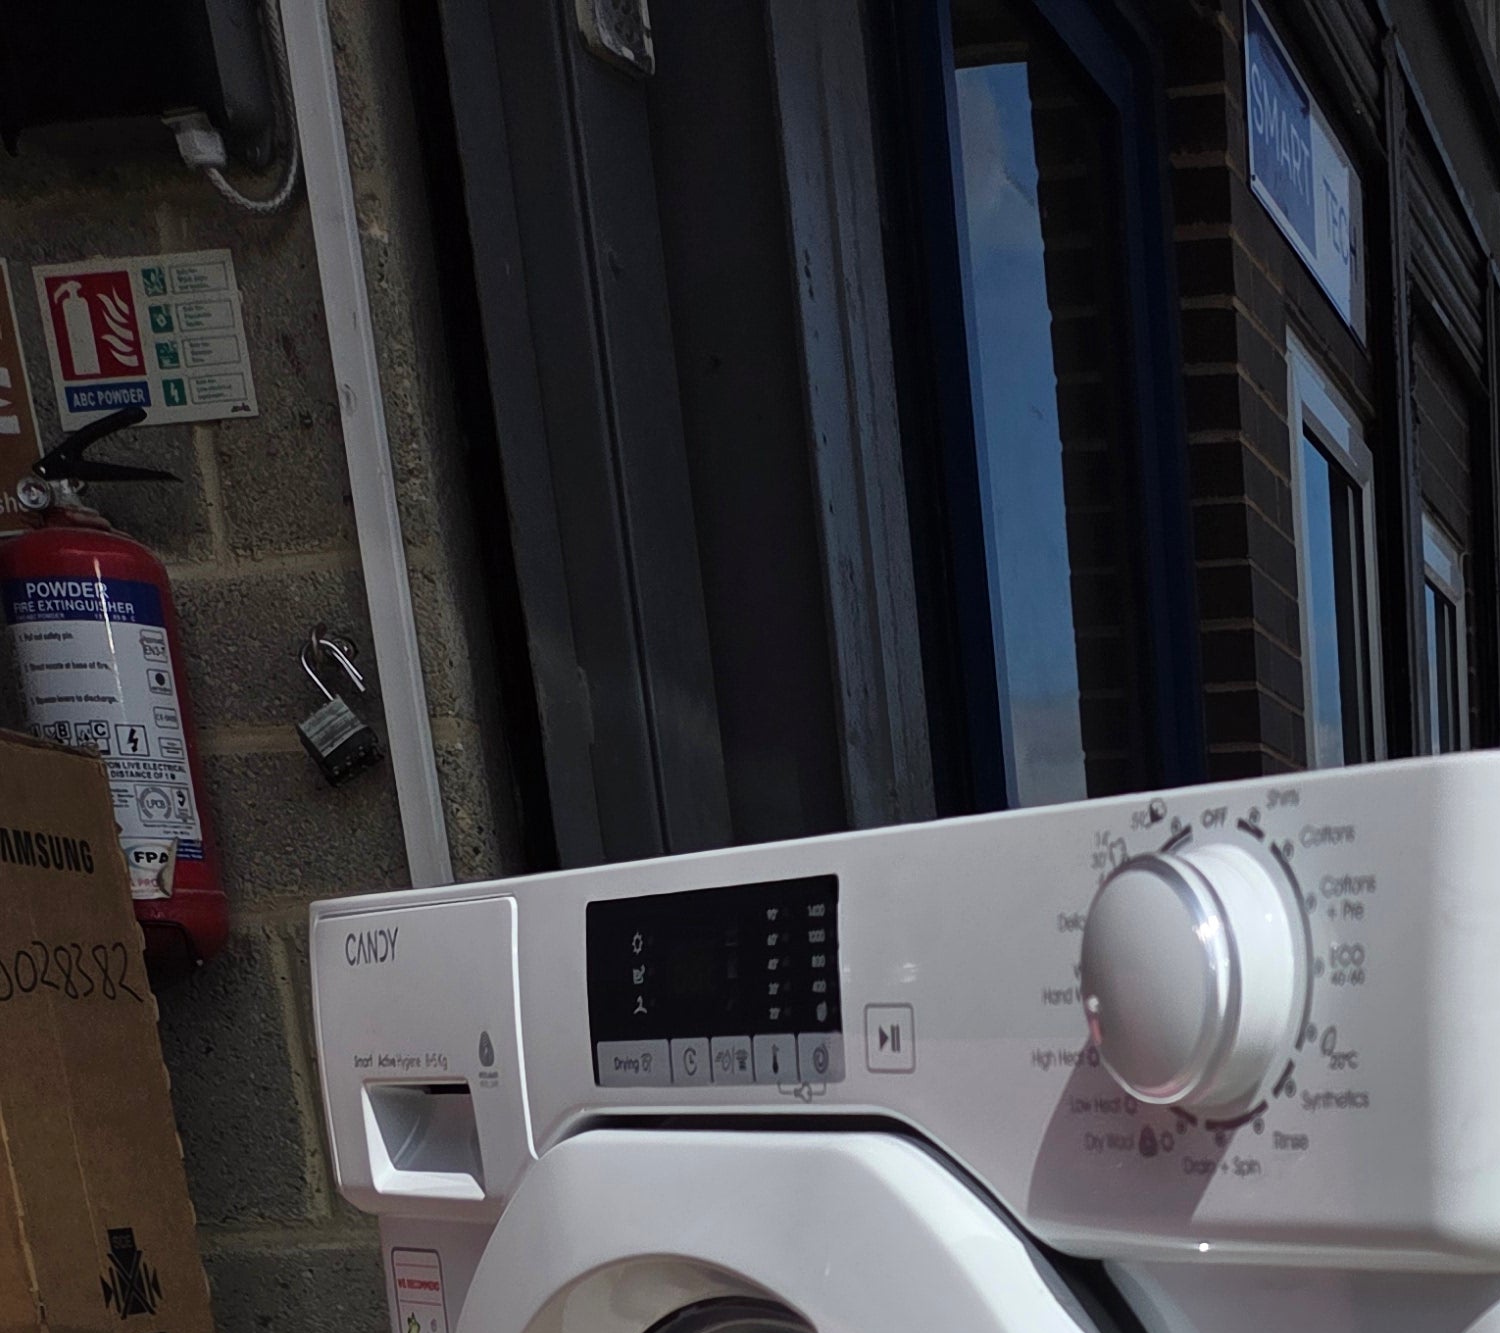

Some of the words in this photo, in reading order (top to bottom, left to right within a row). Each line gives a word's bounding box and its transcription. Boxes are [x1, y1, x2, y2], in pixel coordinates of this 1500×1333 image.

[1251, 63, 1310, 206] SMART
[1323, 175, 1358, 283] TECH
[72, 392, 96, 408] ABC
[98, 388, 145, 405] POWDER
[26, 581, 109, 599] POWDER
[13, 601, 35, 614] FIRE
[38, 600, 135, 615] EXTINGUISHER
[58, 724, 68, 737] B
[94, 723, 107, 737] C
[110, 769, 152, 779] DISTANCE
[123, 762, 141, 771] LIVE
[143, 763, 186, 774] ELECTRICAL
[1201, 806, 1228, 829] OFF
[0, 827, 94, 874] AMSUNG
[345, 927, 399, 966] CANDY
[614, 1056, 640, 1075] Drying
[1301, 1089, 1370, 1112] Synthetics
[1232, 1155, 1261, 1178] Spin
